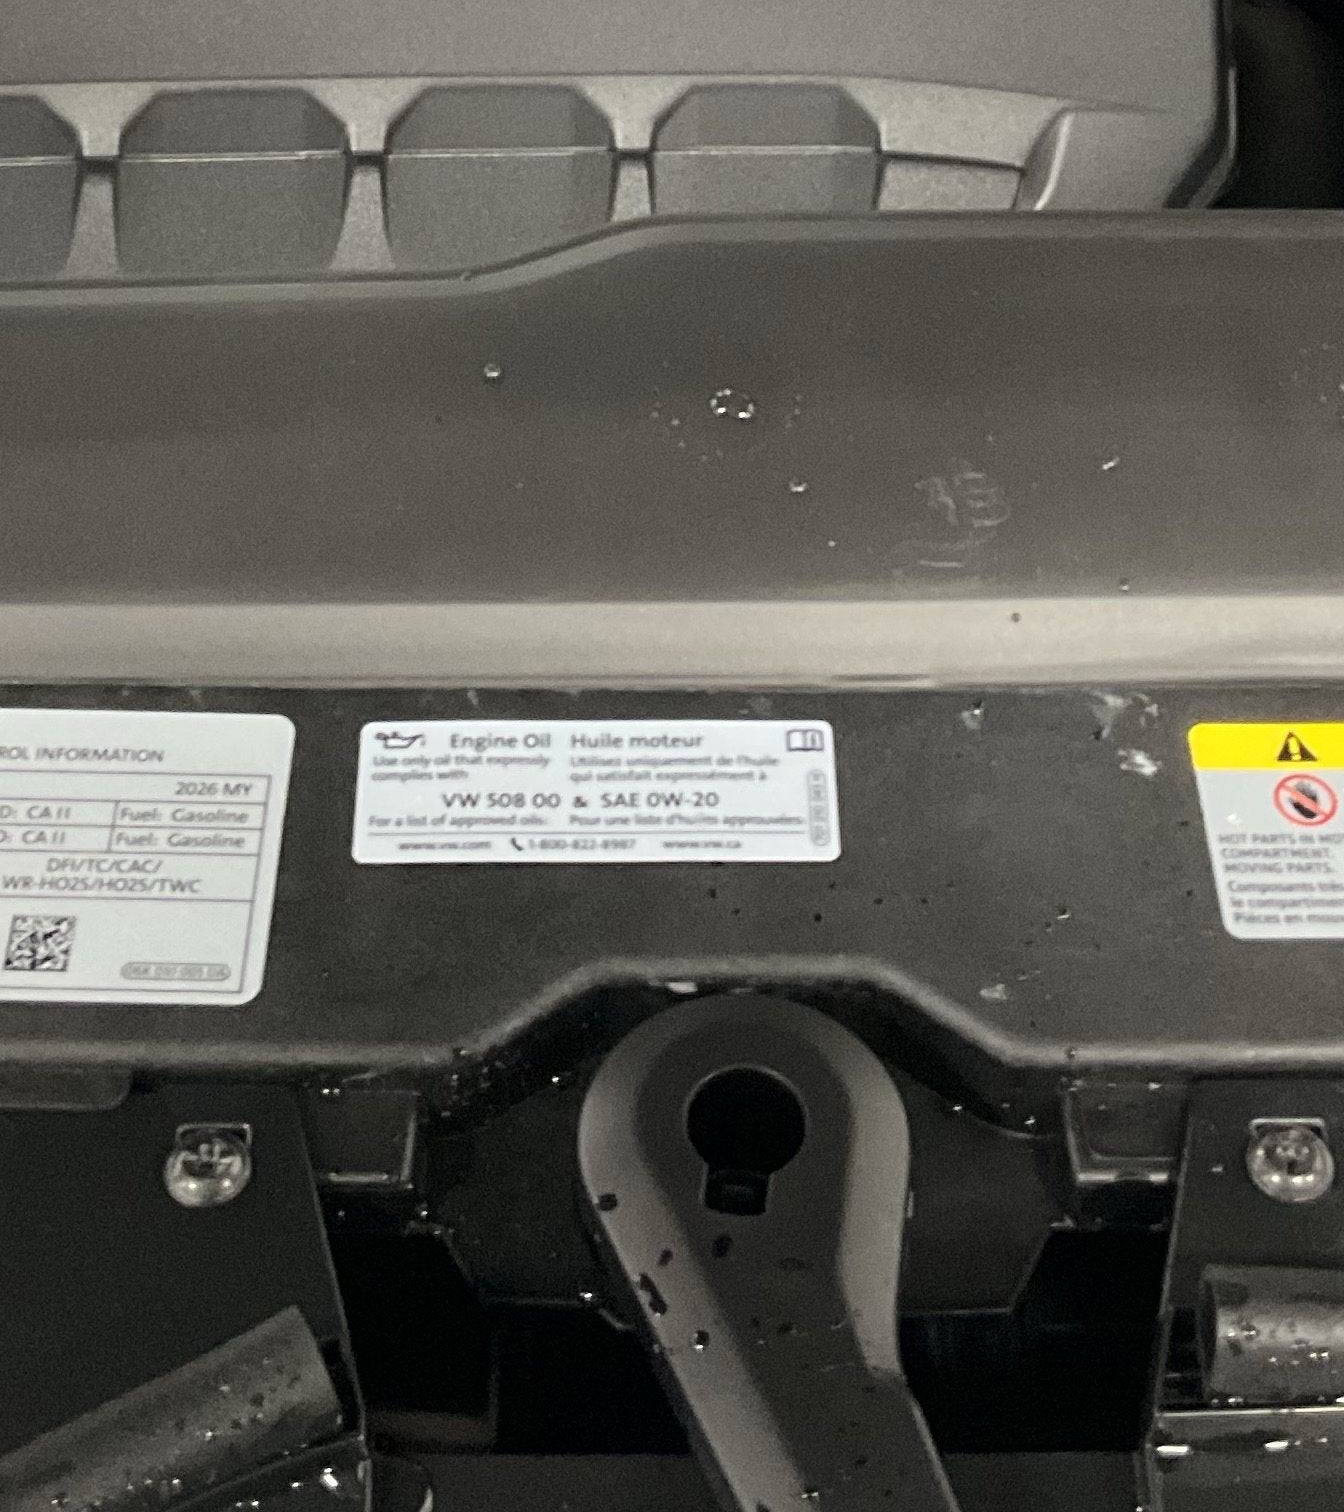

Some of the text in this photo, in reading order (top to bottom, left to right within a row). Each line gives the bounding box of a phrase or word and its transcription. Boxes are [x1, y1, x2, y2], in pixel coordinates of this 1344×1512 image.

[451, 733, 551, 752] Engine Oil
[571, 734, 703, 748] Huile moteur
[35, 747, 165, 763] INFORMATION
[175, 781, 253, 796] 2026 MY
[441, 791, 720, 809] VW 508 00 & SAE 0W-20
[27, 805, 53, 819] CA
[120, 807, 250, 824] Fuel: Gasoline
[22, 829, 47, 845] CA
[115, 832, 246, 849] Fuel: Gasoline
[46, 857, 164, 873] DFI/TC/CAC/
